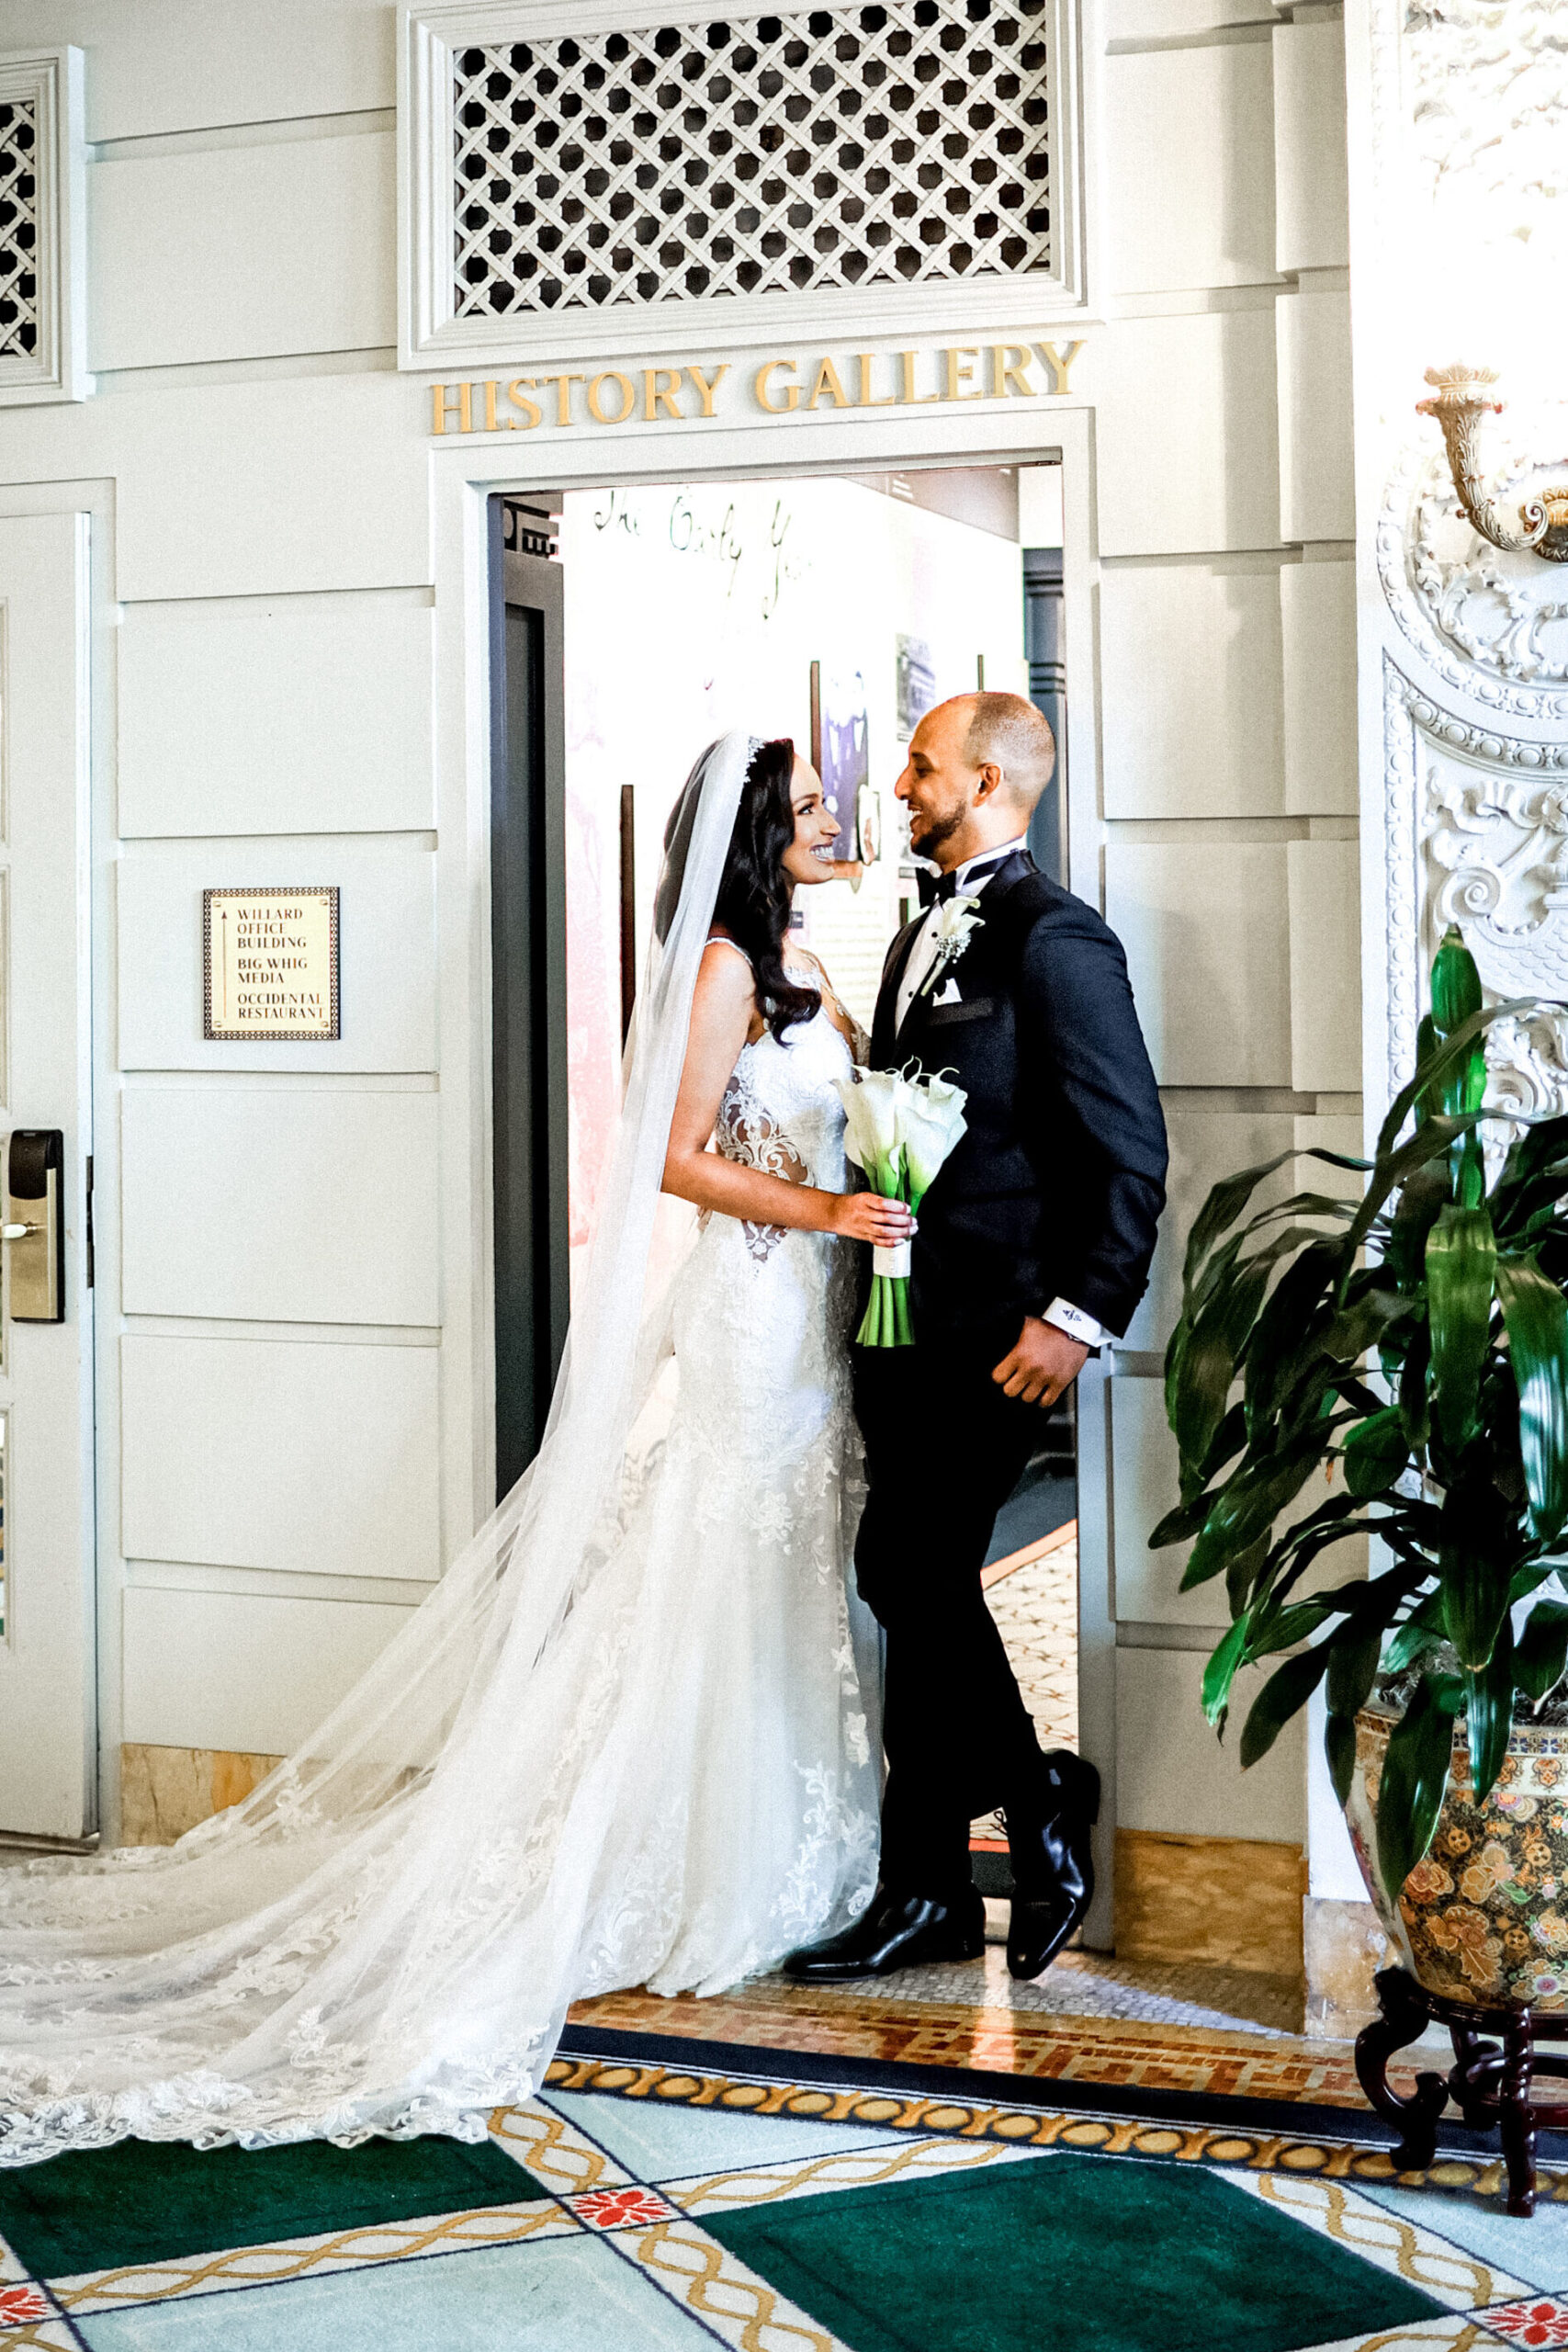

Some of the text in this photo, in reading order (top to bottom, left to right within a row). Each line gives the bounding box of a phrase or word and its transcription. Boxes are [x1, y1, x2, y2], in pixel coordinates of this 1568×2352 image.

[430, 339, 1088, 435] HISTORY GALLERY
[237, 909, 303, 920] WILLARD
[237, 922, 287, 934] OFFICE
[237, 937, 307, 949] BUILDING
[237, 957, 308, 969] BIG WHIG
[237, 972, 285, 984] MEDIA
[237, 993, 323, 1005] OCCIDENTAL
[237, 1008, 324, 1019] RESTAURANT
